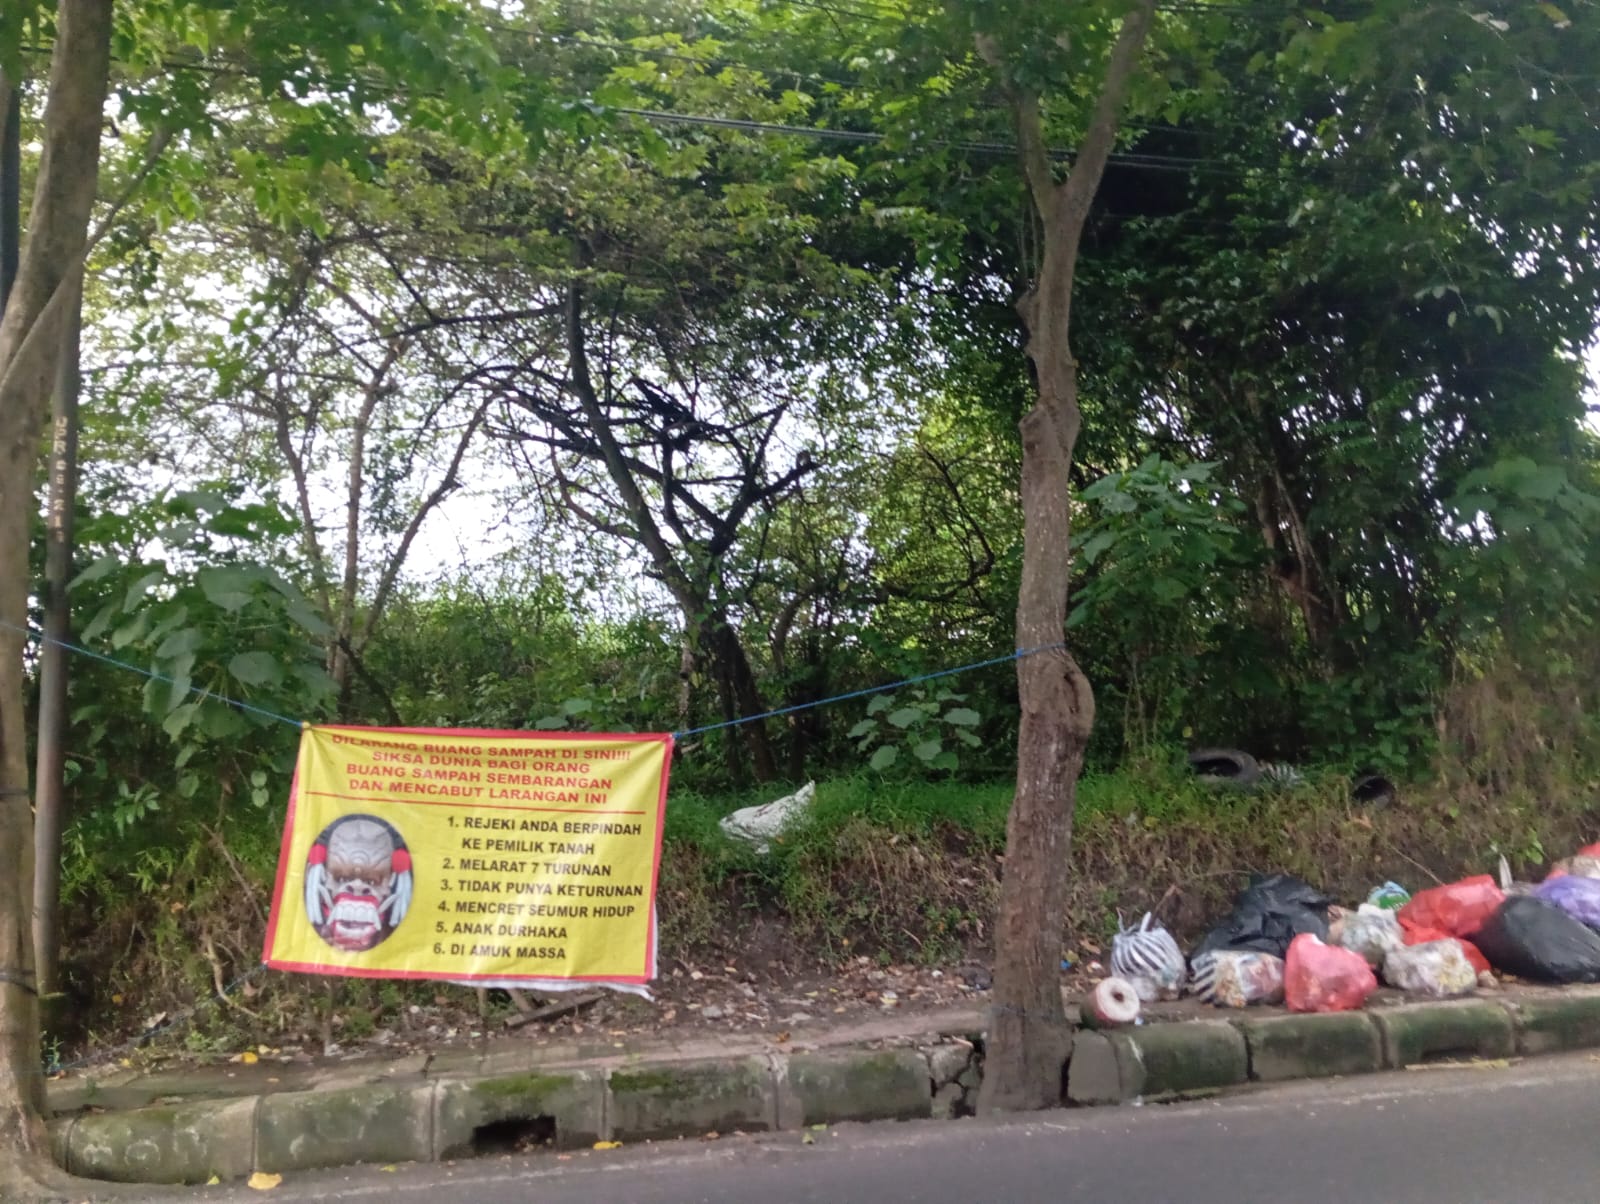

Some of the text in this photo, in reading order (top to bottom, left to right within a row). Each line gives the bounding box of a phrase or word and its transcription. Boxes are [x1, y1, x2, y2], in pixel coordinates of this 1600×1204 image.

[424, 743, 482, 756] BUANG
[488, 747, 556, 759] SAMPAH
[562, 749, 577, 759] DI
[373, 751, 590, 774] SIKSA DUNIA BAGI ORANG
[347, 763, 612, 790] BUANG SAMPAH SEMBARANGAN
[350, 779, 607, 804] DAN MENCABUT LARANGAN INI
[447, 816, 641, 835] 1. REJEKI ANDA BERPINDAH
[462, 838, 595, 855] KE PEMILIK TANAH
[442, 858, 611, 877] 2. MELARAT 7 TURUNAN
[440, 879, 643, 897] 3. TIDAK PUNYA KETURUNAN
[437, 900, 634, 918] 4. MENCRET SEUMUR HIDUP
[435, 921, 568, 939] 5. ANAK DURHAKA
[433, 943, 566, 959] 6. DI AMUK MASSA
